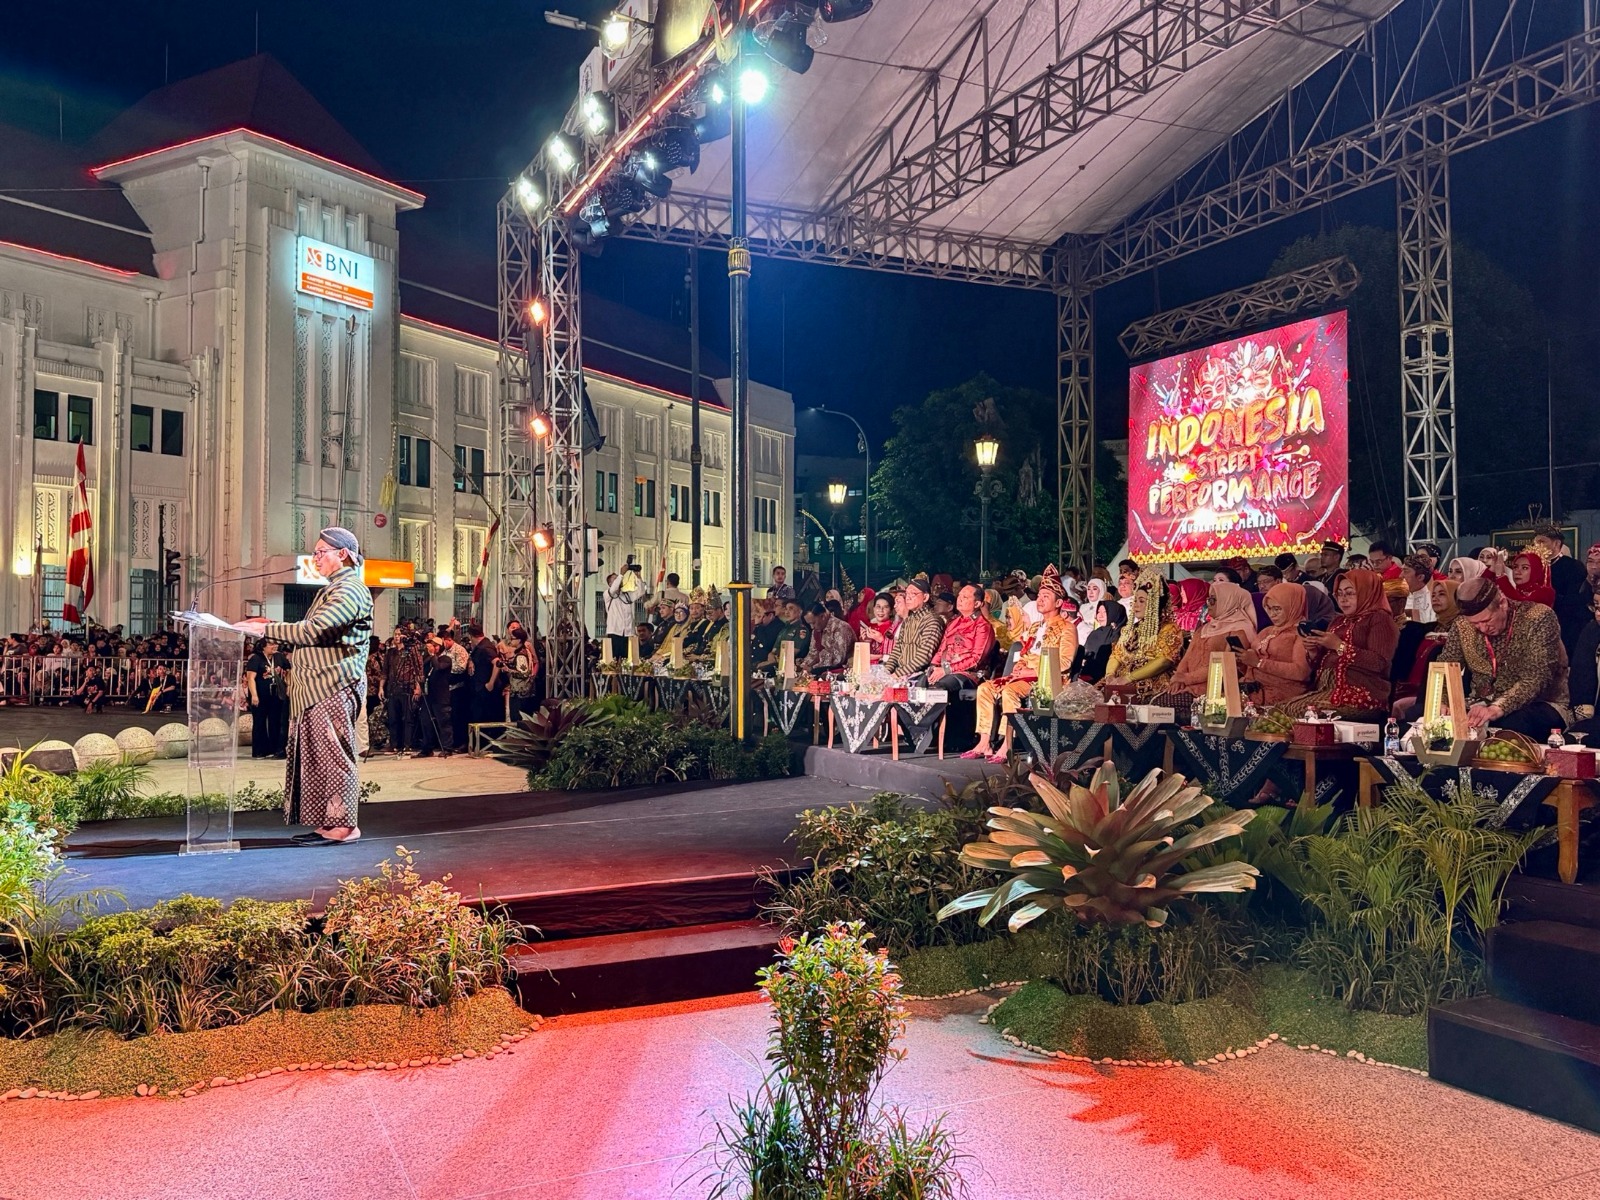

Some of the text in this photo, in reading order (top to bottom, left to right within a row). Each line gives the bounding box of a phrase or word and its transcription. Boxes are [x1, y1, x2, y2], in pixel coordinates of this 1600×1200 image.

[326, 253, 358, 279] BNI
[1146, 385, 1326, 461] INDONESIA
[1197, 446, 1259, 478] STREET
[1148, 460, 1322, 515] PERFORMANCE
